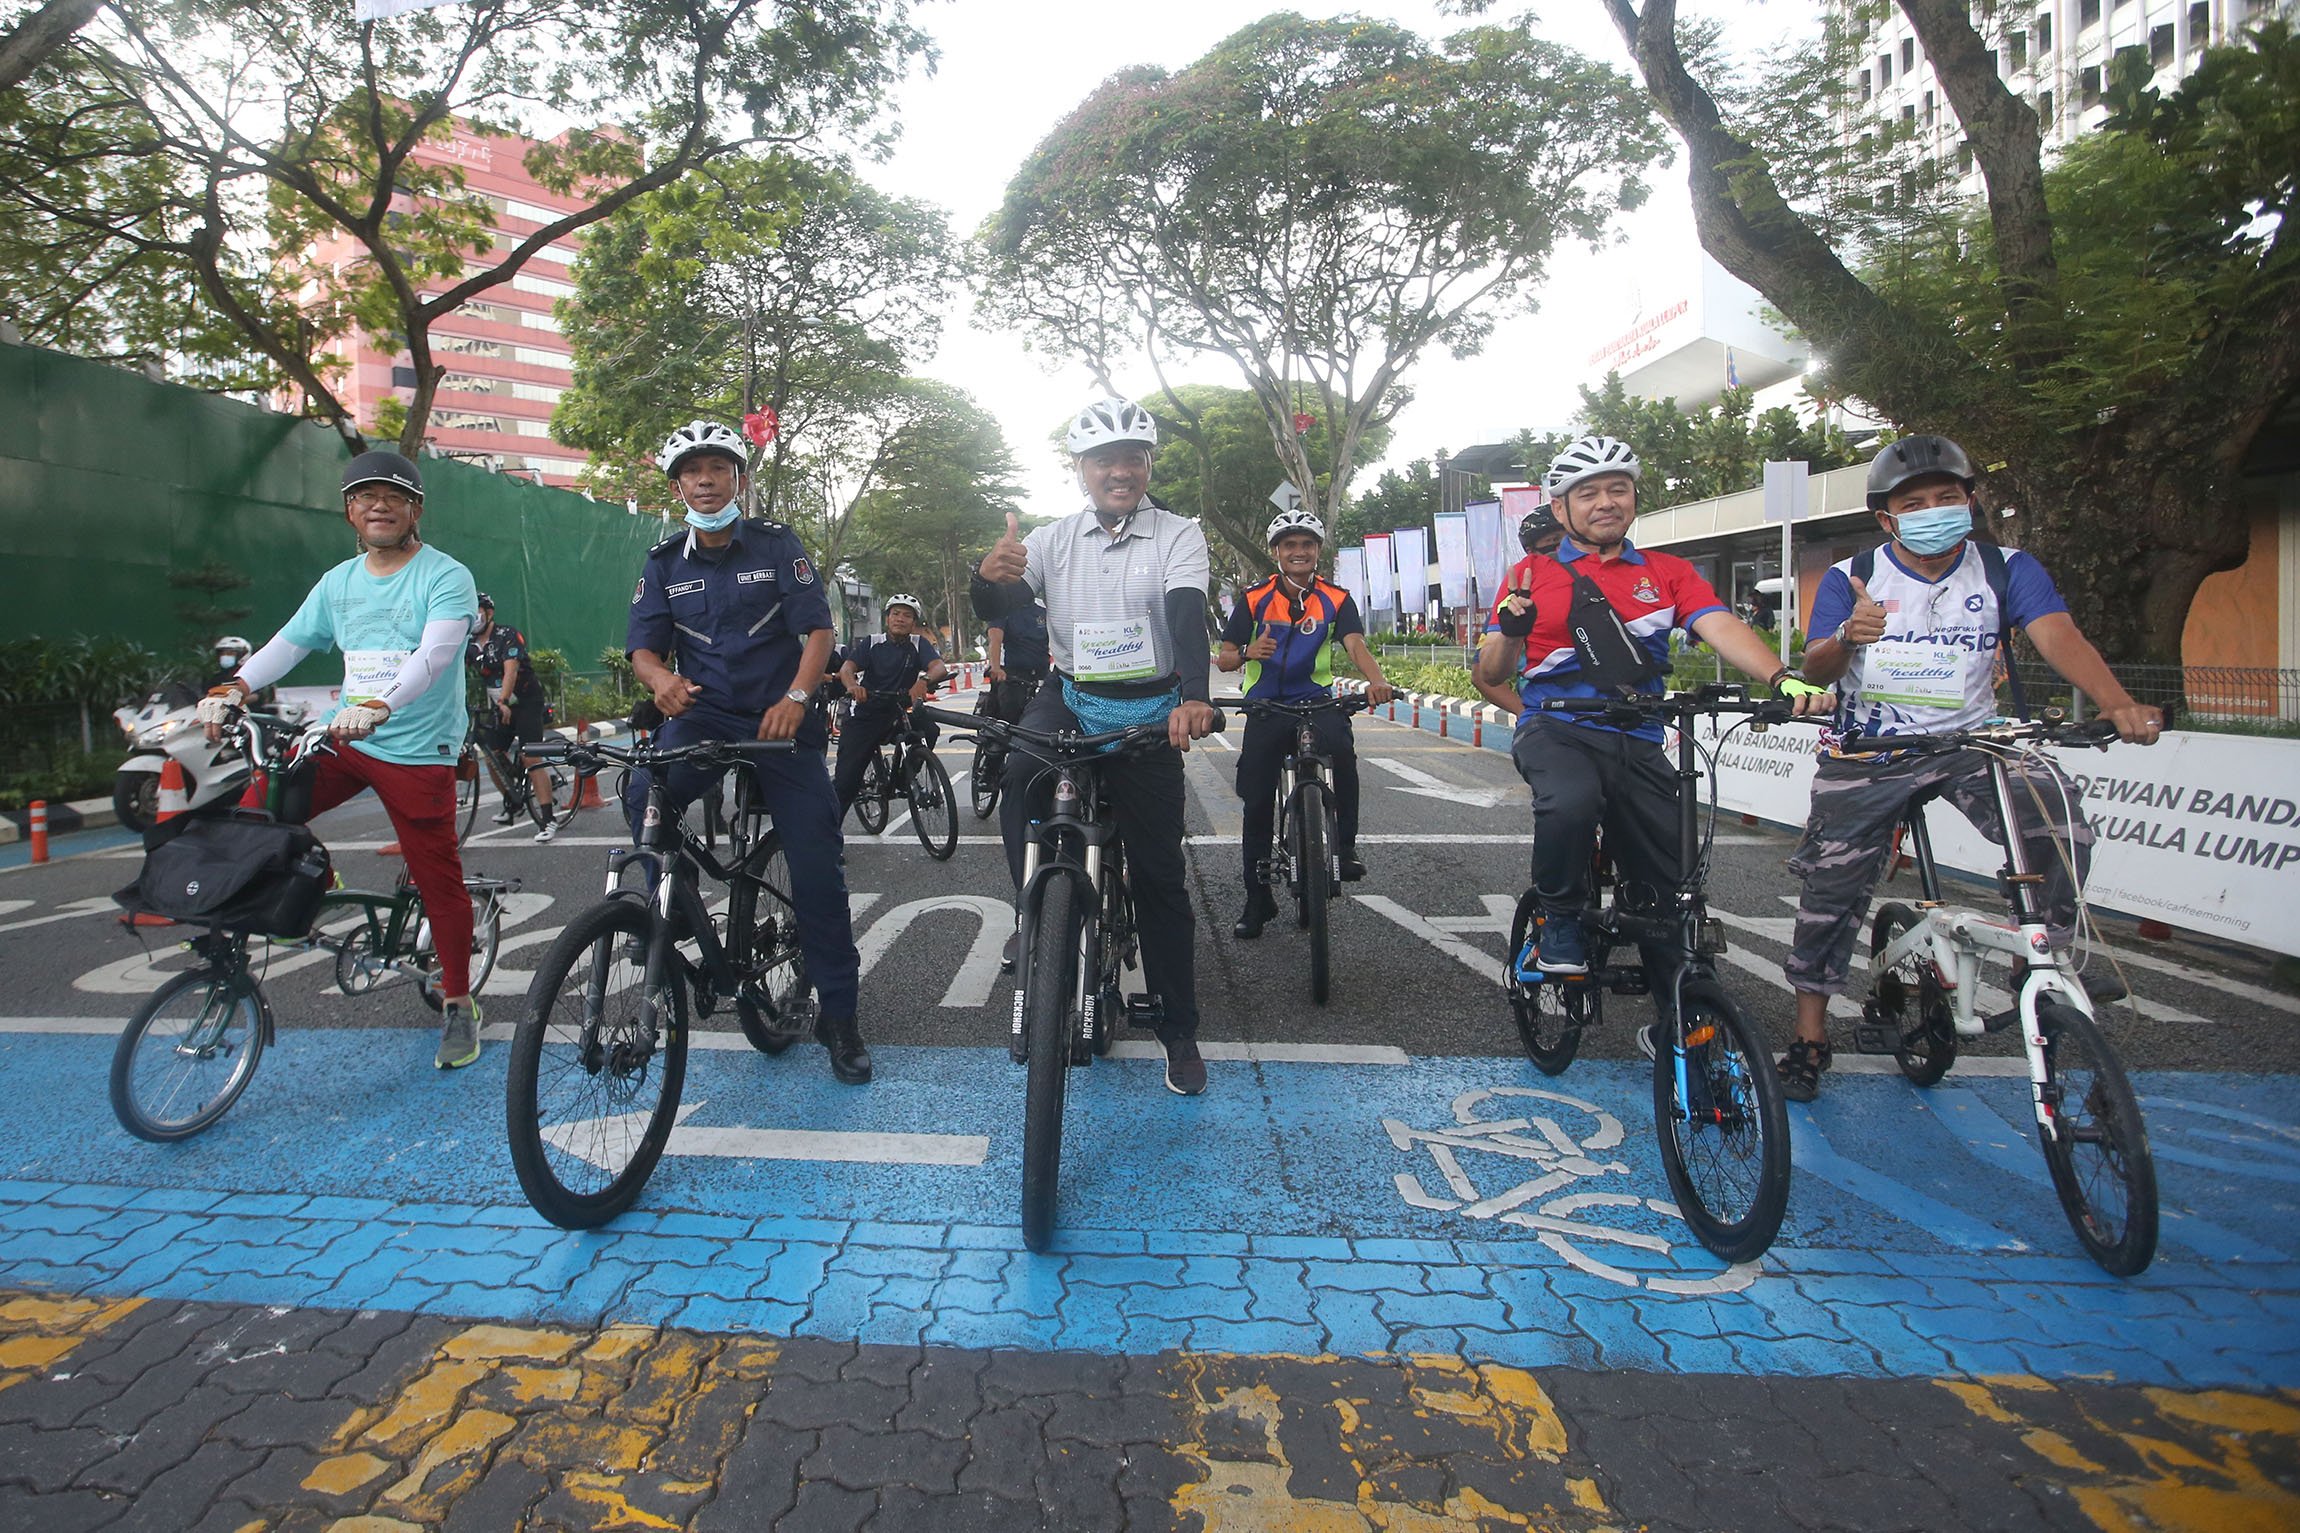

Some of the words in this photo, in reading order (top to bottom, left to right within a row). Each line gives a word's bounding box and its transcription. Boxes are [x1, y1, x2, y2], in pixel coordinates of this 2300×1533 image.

[669, 584, 693, 595] EFFANDY
[1934, 651, 1946, 659] KL
[1741, 755, 1795, 778] LUMPUR
[2073, 774, 2185, 810] DEWAN
[2089, 813, 2186, 853] KUALA
[1935, 921, 1947, 930] FIT
[1012, 990, 1024, 1034] ROCKSHOX
[1083, 994, 1095, 1039] ROCKSHOX
